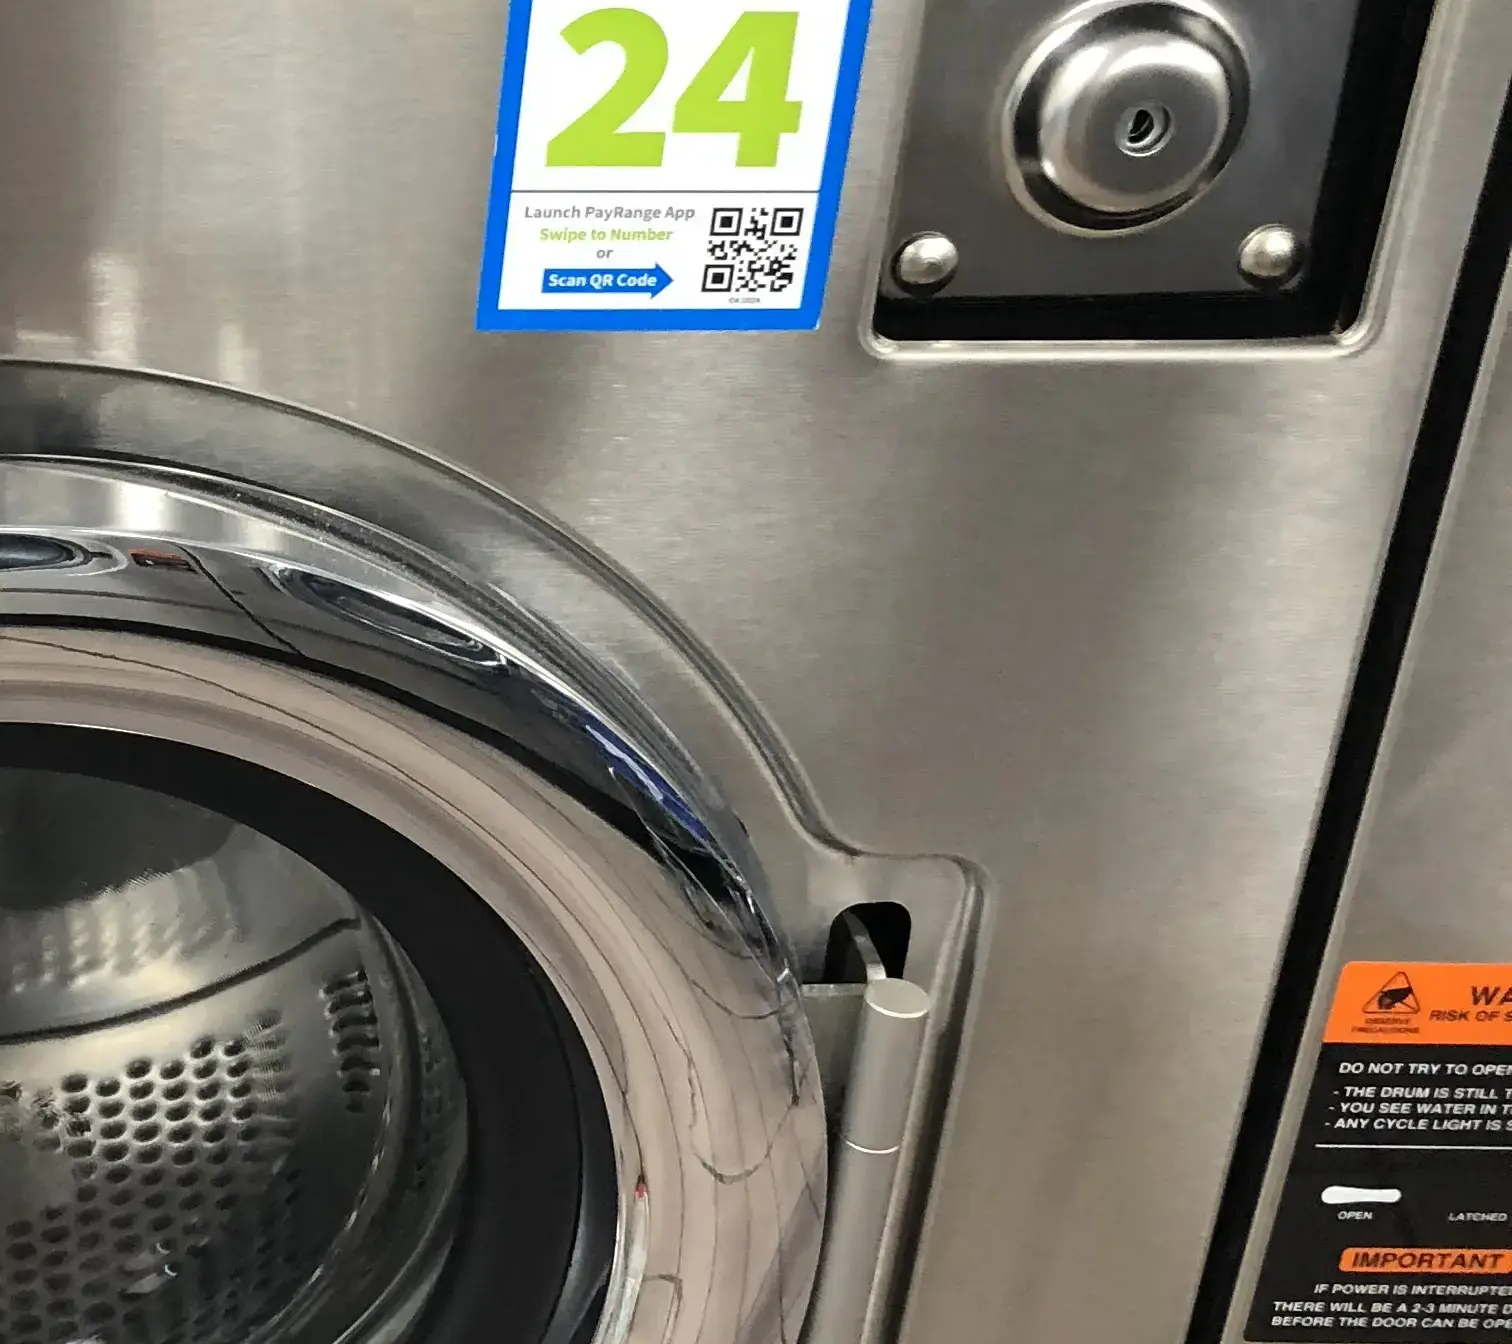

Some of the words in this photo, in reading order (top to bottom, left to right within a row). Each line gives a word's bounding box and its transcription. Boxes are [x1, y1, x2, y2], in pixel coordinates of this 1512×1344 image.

[544, 7, 803, 168] 24
[524, 206, 581, 219] Launch
[584, 206, 662, 222] PayRange
[664, 206, 696, 222] App
[540, 228, 588, 243] Swipe
[591, 229, 606, 241] to
[610, 229, 674, 241] Number
[596, 247, 613, 259] or
[548, 273, 587, 287] Scan
[590, 274, 613, 289] QR
[616, 273, 658, 287] Code
[1428, 1009, 1470, 1022] RISK
[1475, 1010, 1501, 1022] OF
[1351, 1251, 1505, 1269] IMPORTANT
